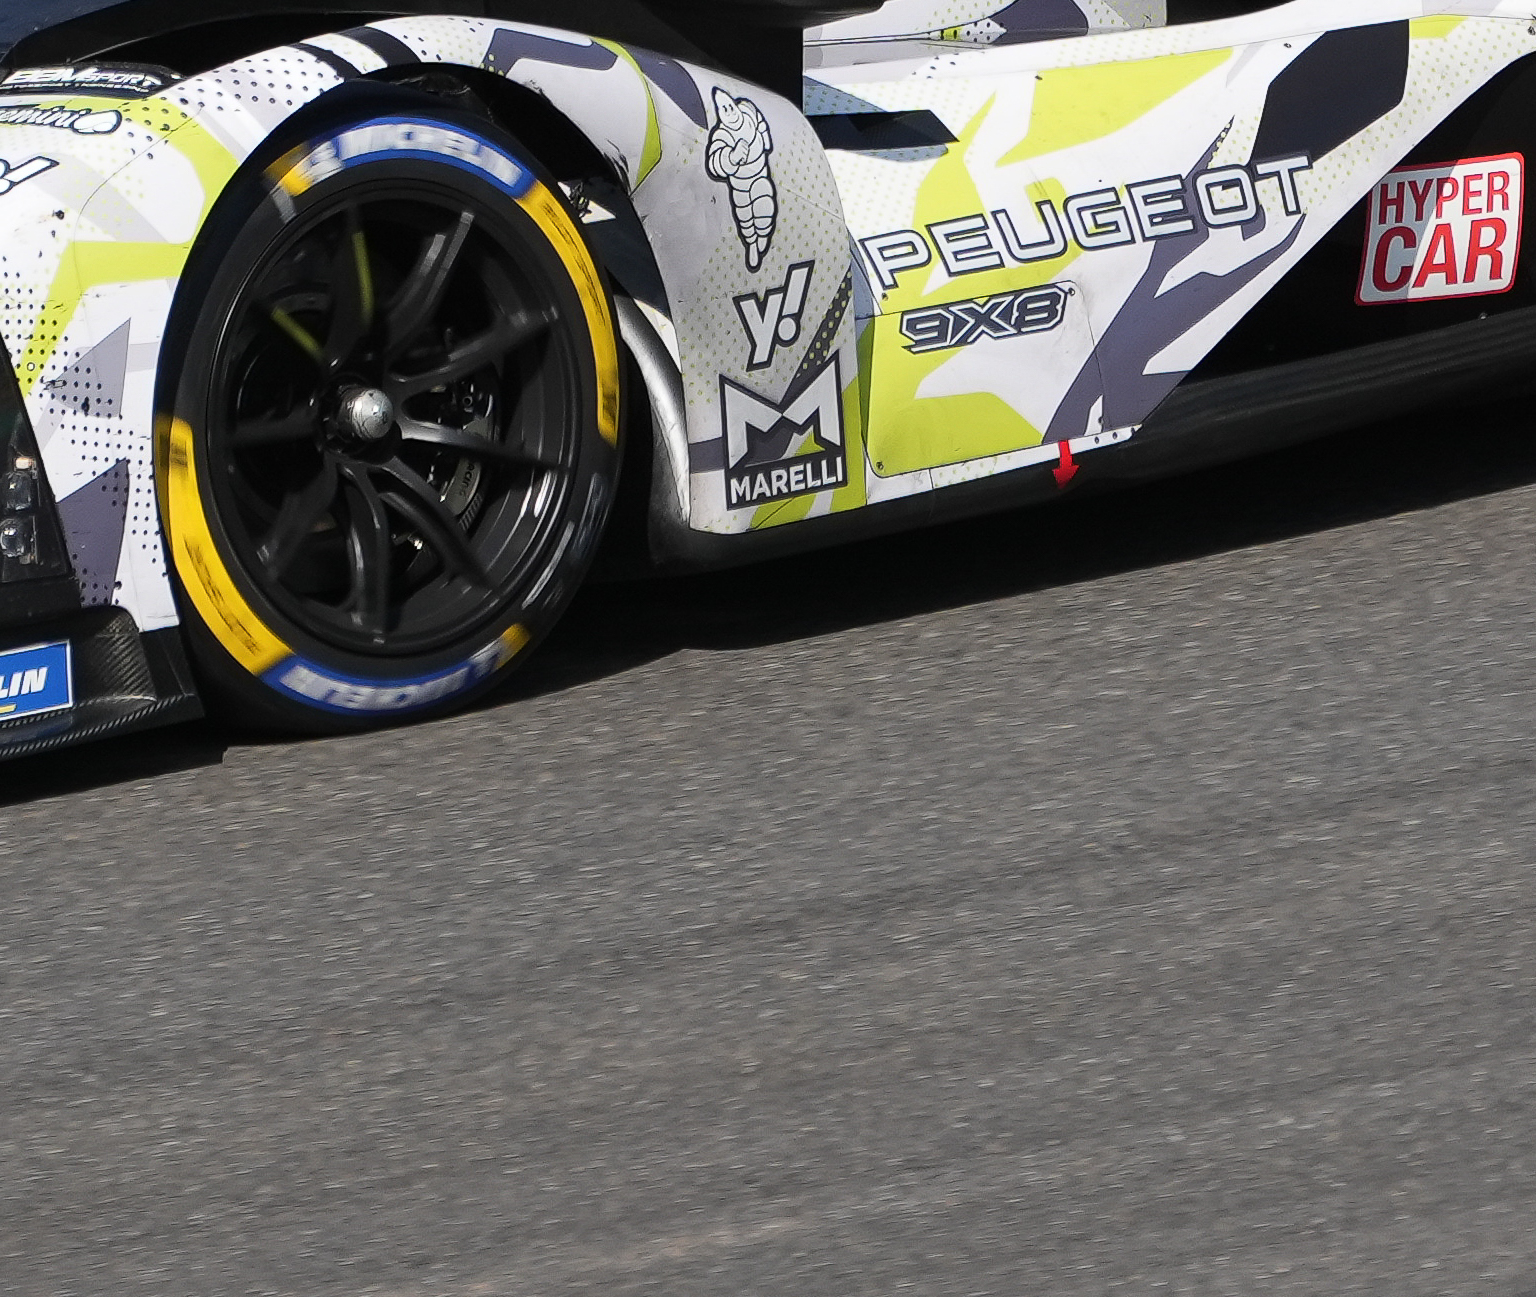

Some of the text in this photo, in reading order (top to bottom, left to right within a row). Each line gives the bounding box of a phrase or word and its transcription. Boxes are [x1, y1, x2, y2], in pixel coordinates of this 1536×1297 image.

[863, 151, 1313, 289] PEUGEOT
[1378, 167, 1511, 227] HYPER
[1372, 217, 1507, 293] CAR
[899, 281, 1067, 355] 9X8
[730, 461, 844, 505] MARELLI
